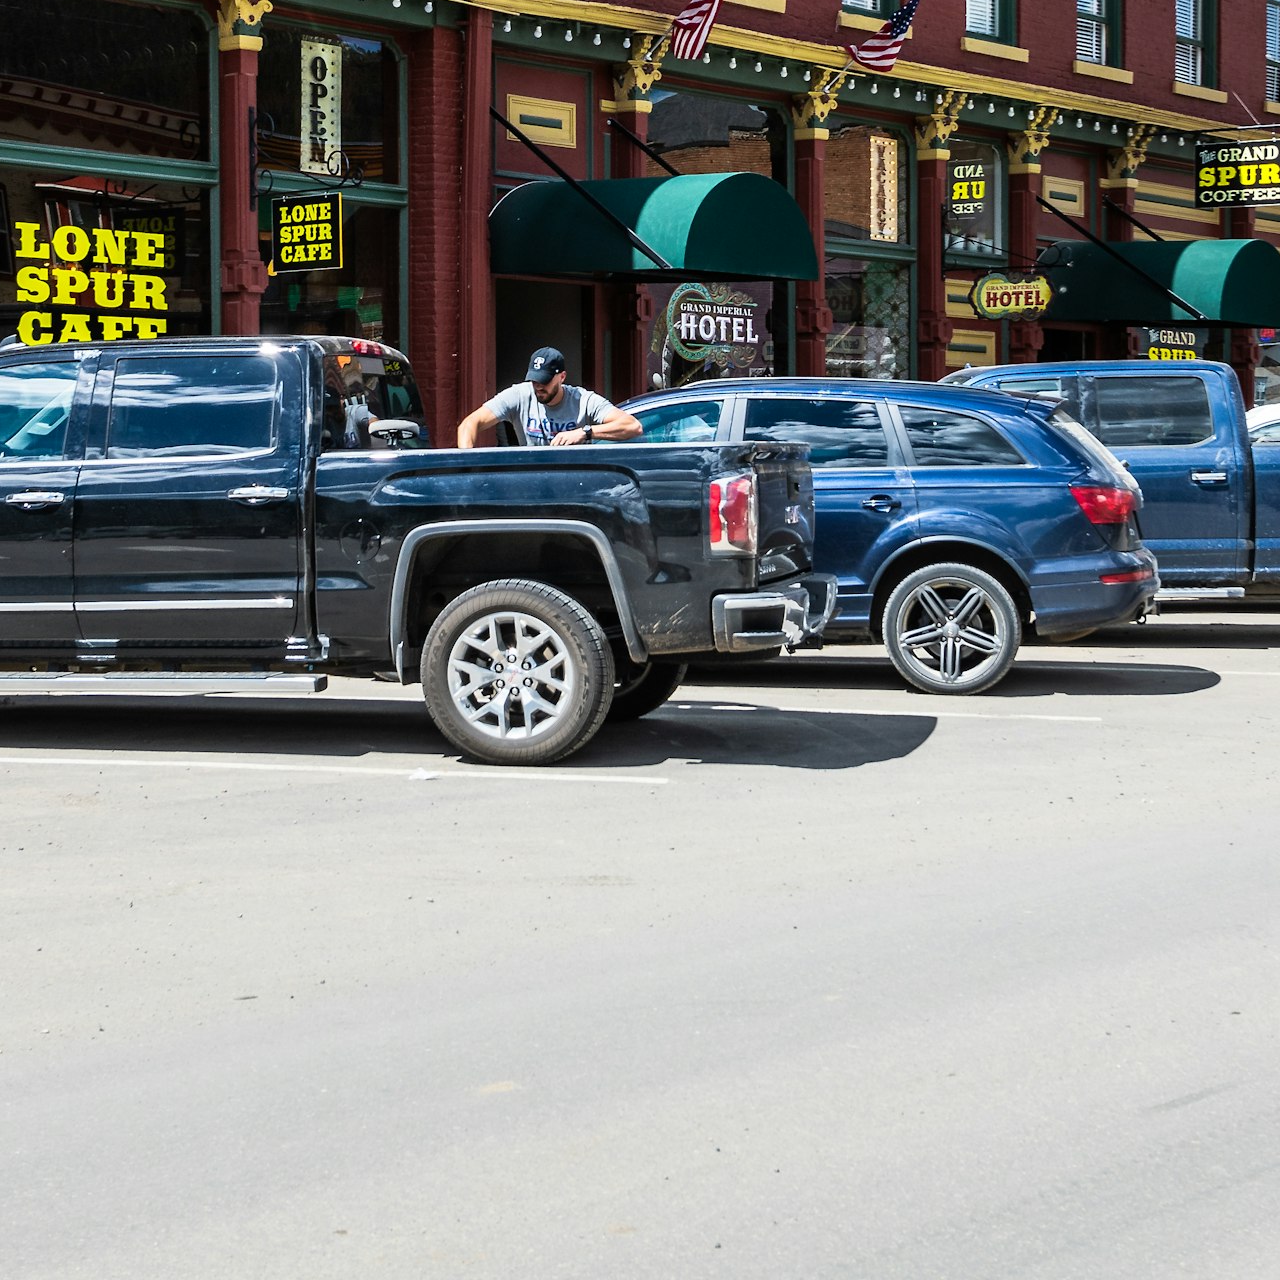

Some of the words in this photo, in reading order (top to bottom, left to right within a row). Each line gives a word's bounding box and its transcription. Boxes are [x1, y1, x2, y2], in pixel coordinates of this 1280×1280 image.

[308, 56, 328, 163] OPEN
[1217, 145, 1279, 162] GRAND
[1199, 163, 1280, 187] SPUR
[1200, 187, 1280, 202] COFFEE
[279, 203, 331, 224] LONE
[280, 223, 332, 243] SPUR
[15, 222, 164, 267] LONE
[280, 243, 332, 263] CAFE
[16, 266, 168, 310] SPUR
[986, 290, 1044, 307] HOTEL
[680, 303, 711, 312] GRAND
[713, 305, 753, 317] IMPERIAL
[16, 311, 167, 346] CAFE
[680, 312, 759, 343] HOTEL
[1159, 330, 1196, 345] GRAND
